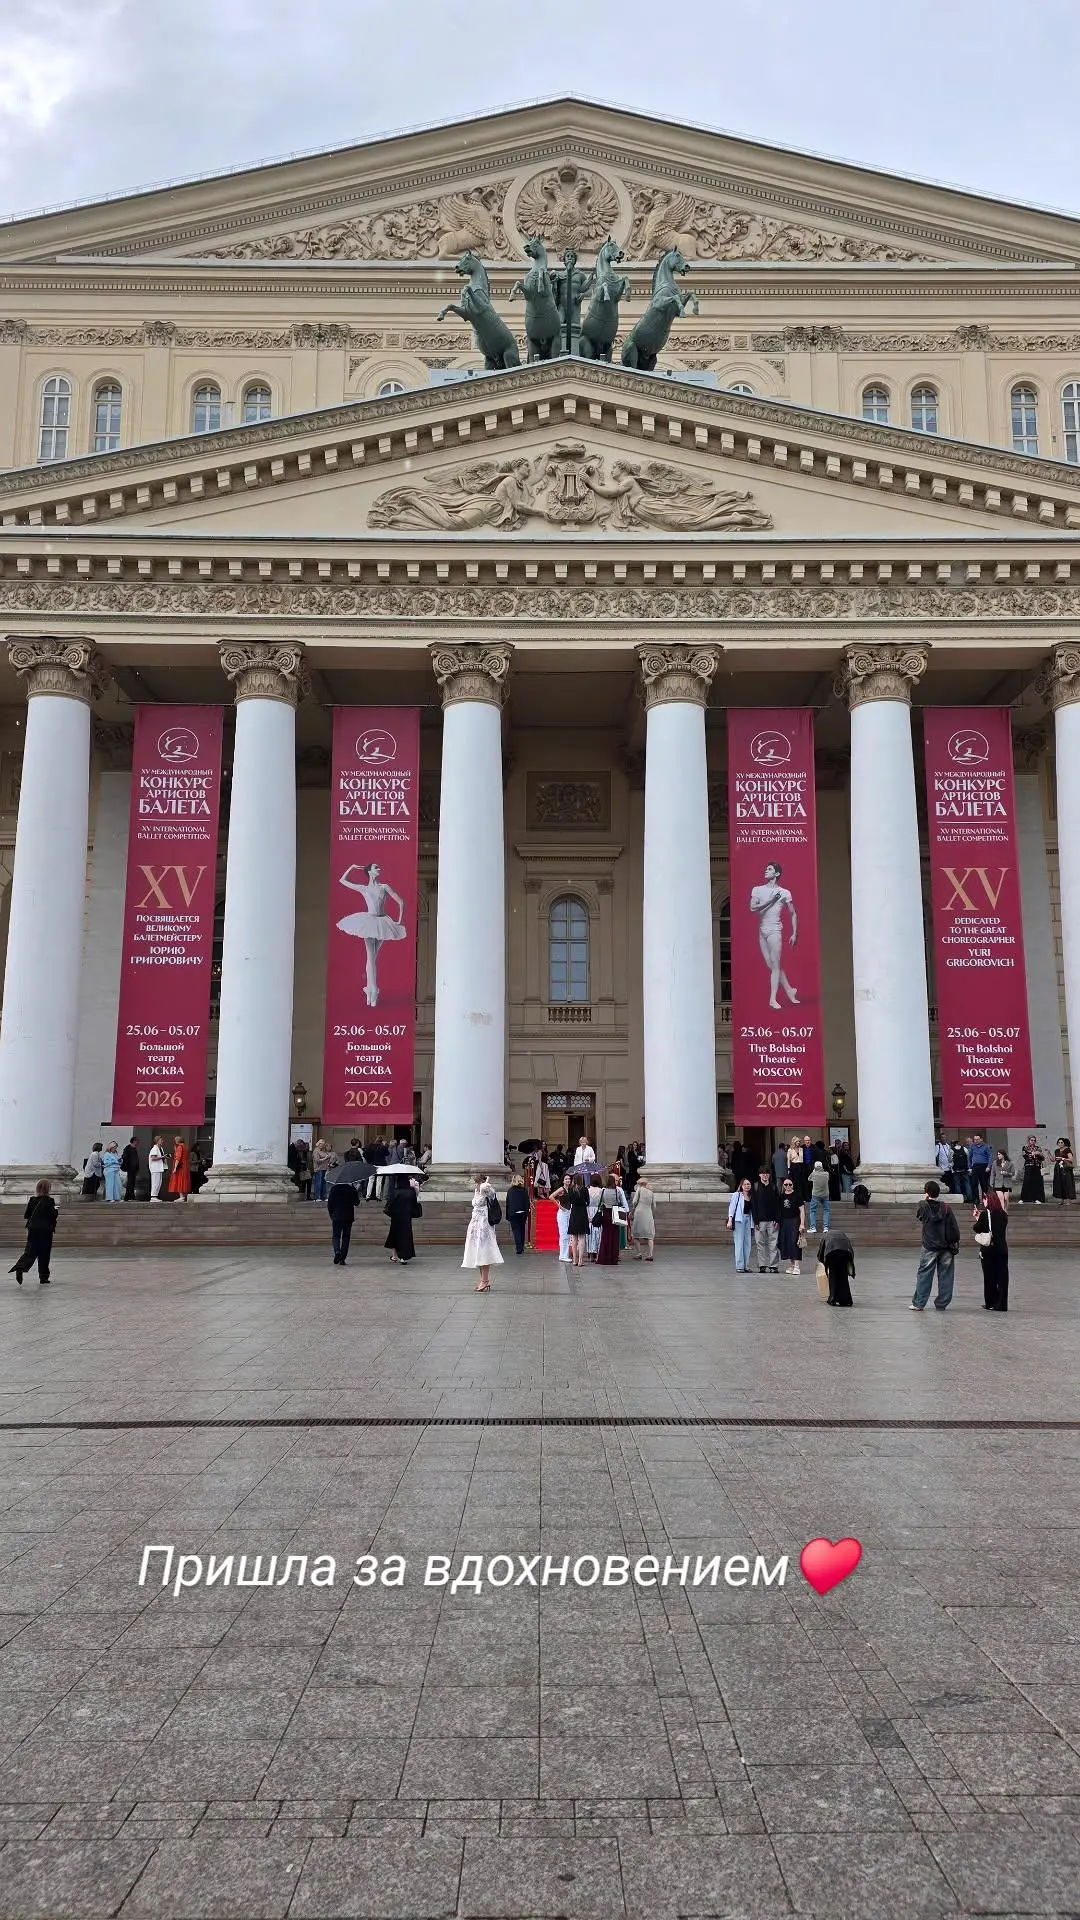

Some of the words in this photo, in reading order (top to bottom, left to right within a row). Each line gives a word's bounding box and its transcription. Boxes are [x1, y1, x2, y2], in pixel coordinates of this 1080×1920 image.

[140, 776, 213, 789] КОНКУРС
[340, 779, 410, 790] КОНКУРС
[736, 780, 806, 792] КОНКУРС
[934, 779, 1006, 790] КОНКУРС
[146, 790, 206, 799] АРТИСТОВ
[346, 790, 404, 800] АРТИСТОВ
[742, 792, 801, 802] АРТИСТОВ
[941, 791, 1000, 800] АРТИСТОВ
[138, 800, 211, 814] БАЛЕТА
[339, 801, 410, 816] БАЛЕТА
[736, 803, 807, 818] БАЛЕТА
[936, 802, 1007, 816] БАЛЕТА
[134, 865, 208, 908] XV
[940, 868, 1008, 910] XV
[136, 915, 200, 923] ПОСВЯЩАЕТСЯ
[146, 924, 191, 932] ВЕЛИКОМУ
[134, 932, 203, 942] БАЛЕТМЕЙСТЕРУ
[942, 936, 1015, 944] CHOREOGRAPHER
[150, 946, 185, 955] ЮРИЮ
[968, 948, 991, 957] YURI
[130, 956, 203, 965] ГРИГОРОВИЧУ
[946, 958, 1014, 967] GRIGOROVICH
[126, 1025, 159, 1036] 25.06
[168, 1025, 200, 1035] 05.07
[333, 1025, 366, 1036] 25.06
[374, 1025, 406, 1036] 05.07
[740, 1027, 772, 1037] 25.06
[782, 1027, 813, 1037] 05.07
[947, 1028, 979, 1038] 25.06
[988, 1028, 1020, 1038] 05.07
[139, 1042, 184, 1051] Большой
[346, 1042, 391, 1051] Большой
[749, 1044, 768, 1053] The
[769, 1044, 806, 1053] Bolshoi
[956, 1044, 974, 1053] The
[976, 1044, 1013, 1053] Bolshoi
[148, 1054, 175, 1063] театр
[355, 1054, 382, 1063] театр
[758, 1055, 796, 1064] Theatre
[966, 1055, 1004, 1064] Theatre
[136, 1066, 184, 1075] МОСКВА
[344, 1066, 392, 1075] МОСКВА
[753, 1068, 803, 1077] MOSCOW
[960, 1068, 1011, 1077] MOSCOW
[136, 1090, 182, 1107] 2026
[344, 1090, 390, 1107] 2026
[756, 1092, 802, 1108] 2026
[964, 1093, 1011, 1109] 2026
